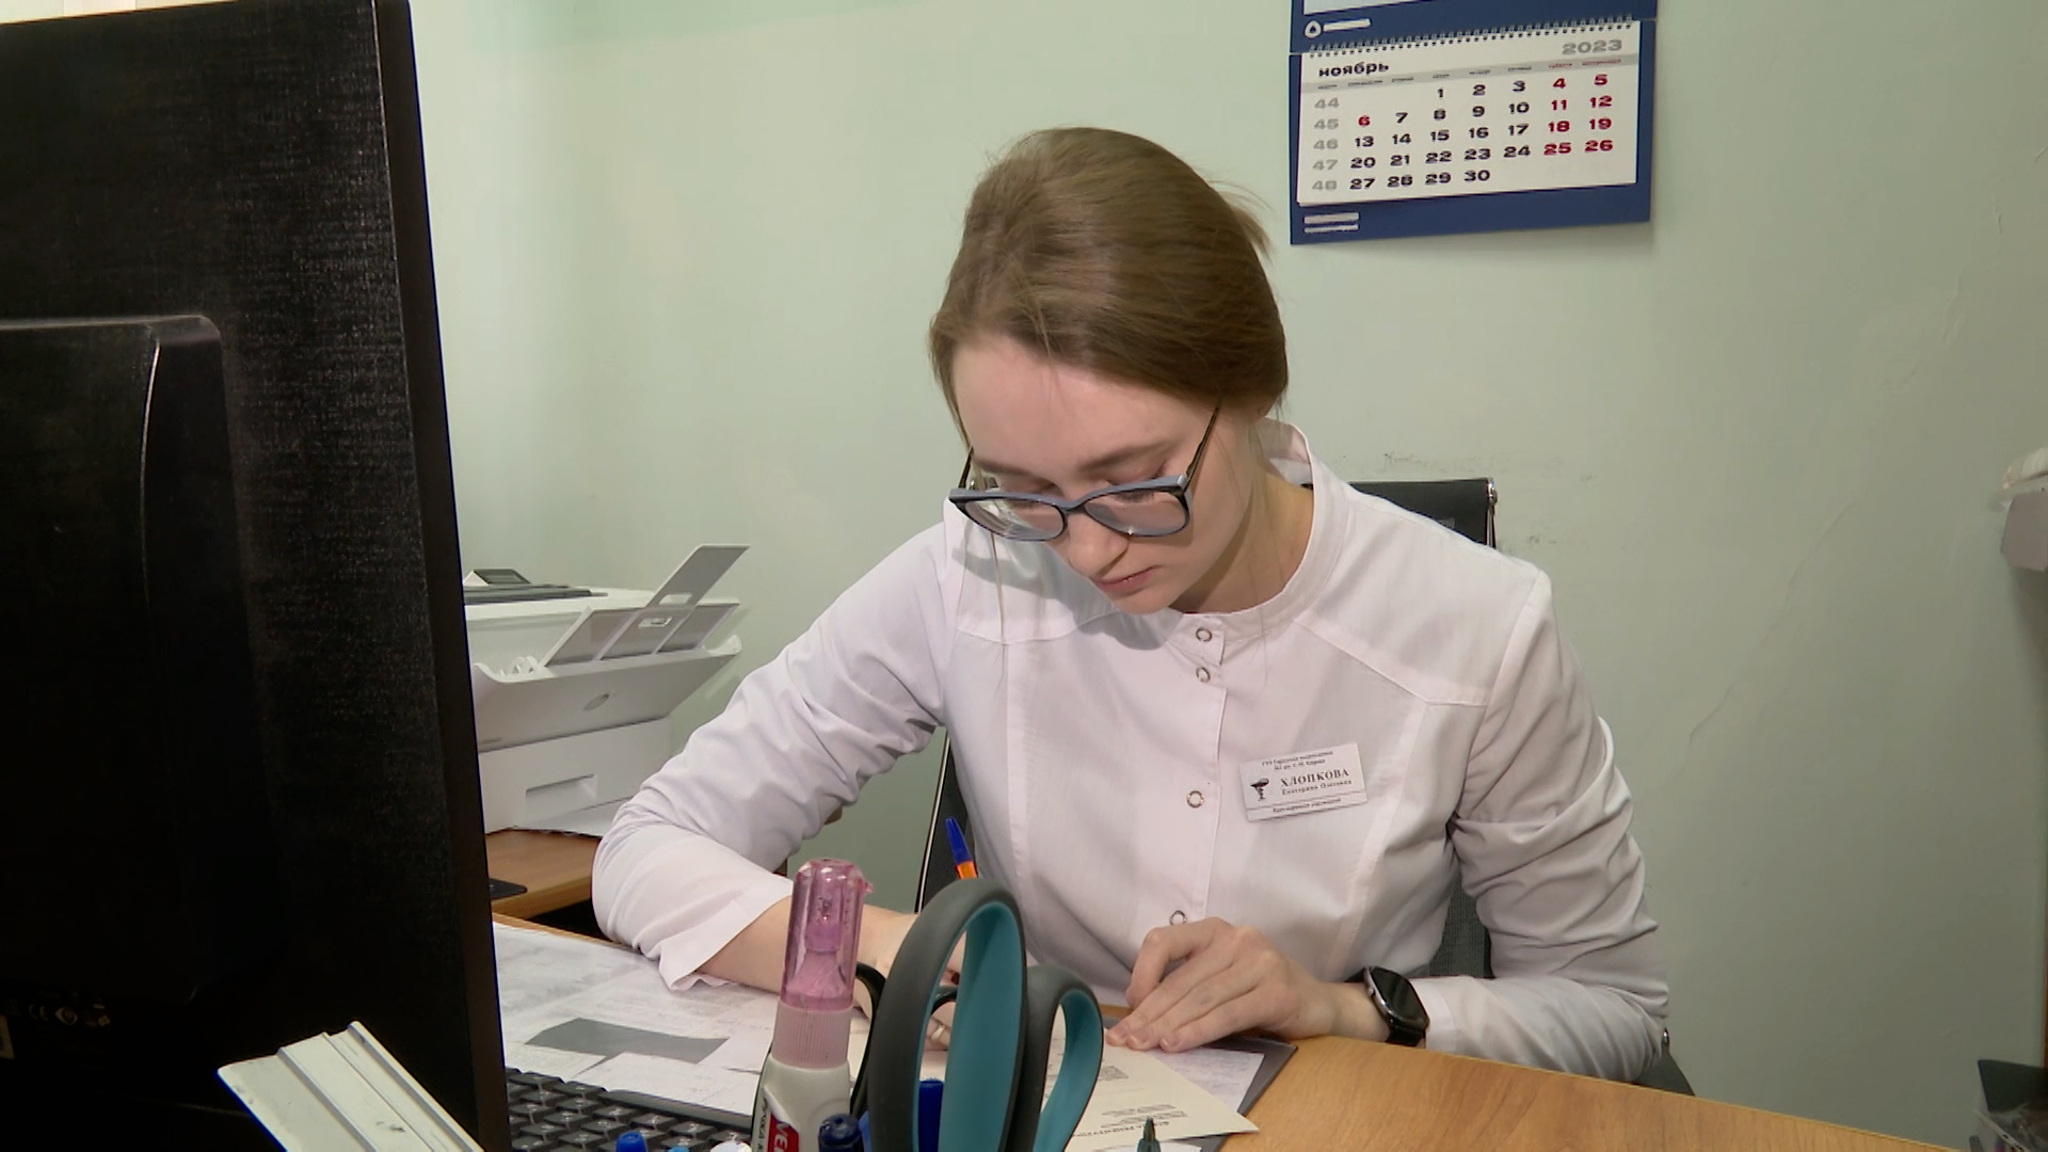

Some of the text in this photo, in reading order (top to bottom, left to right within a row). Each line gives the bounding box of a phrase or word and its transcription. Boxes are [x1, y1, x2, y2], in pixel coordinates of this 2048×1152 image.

[1562, 39, 1622, 55] 2023
[1319, 61, 1389, 77] ноябрь
[1314, 73, 1608, 109] 44 1 2 3 4 5
[1313, 95, 1613, 130] 45 6 7 8 9 10 11 12
[1313, 118, 1612, 151] 46 13 14 15 16 17 18 19
[1312, 139, 1614, 171] 47 20 21 22 23 24 25 26
[1311, 169, 1491, 191] 48 27 28 29 30
[1280, 769, 1349, 787] ХЛОПКОВА
